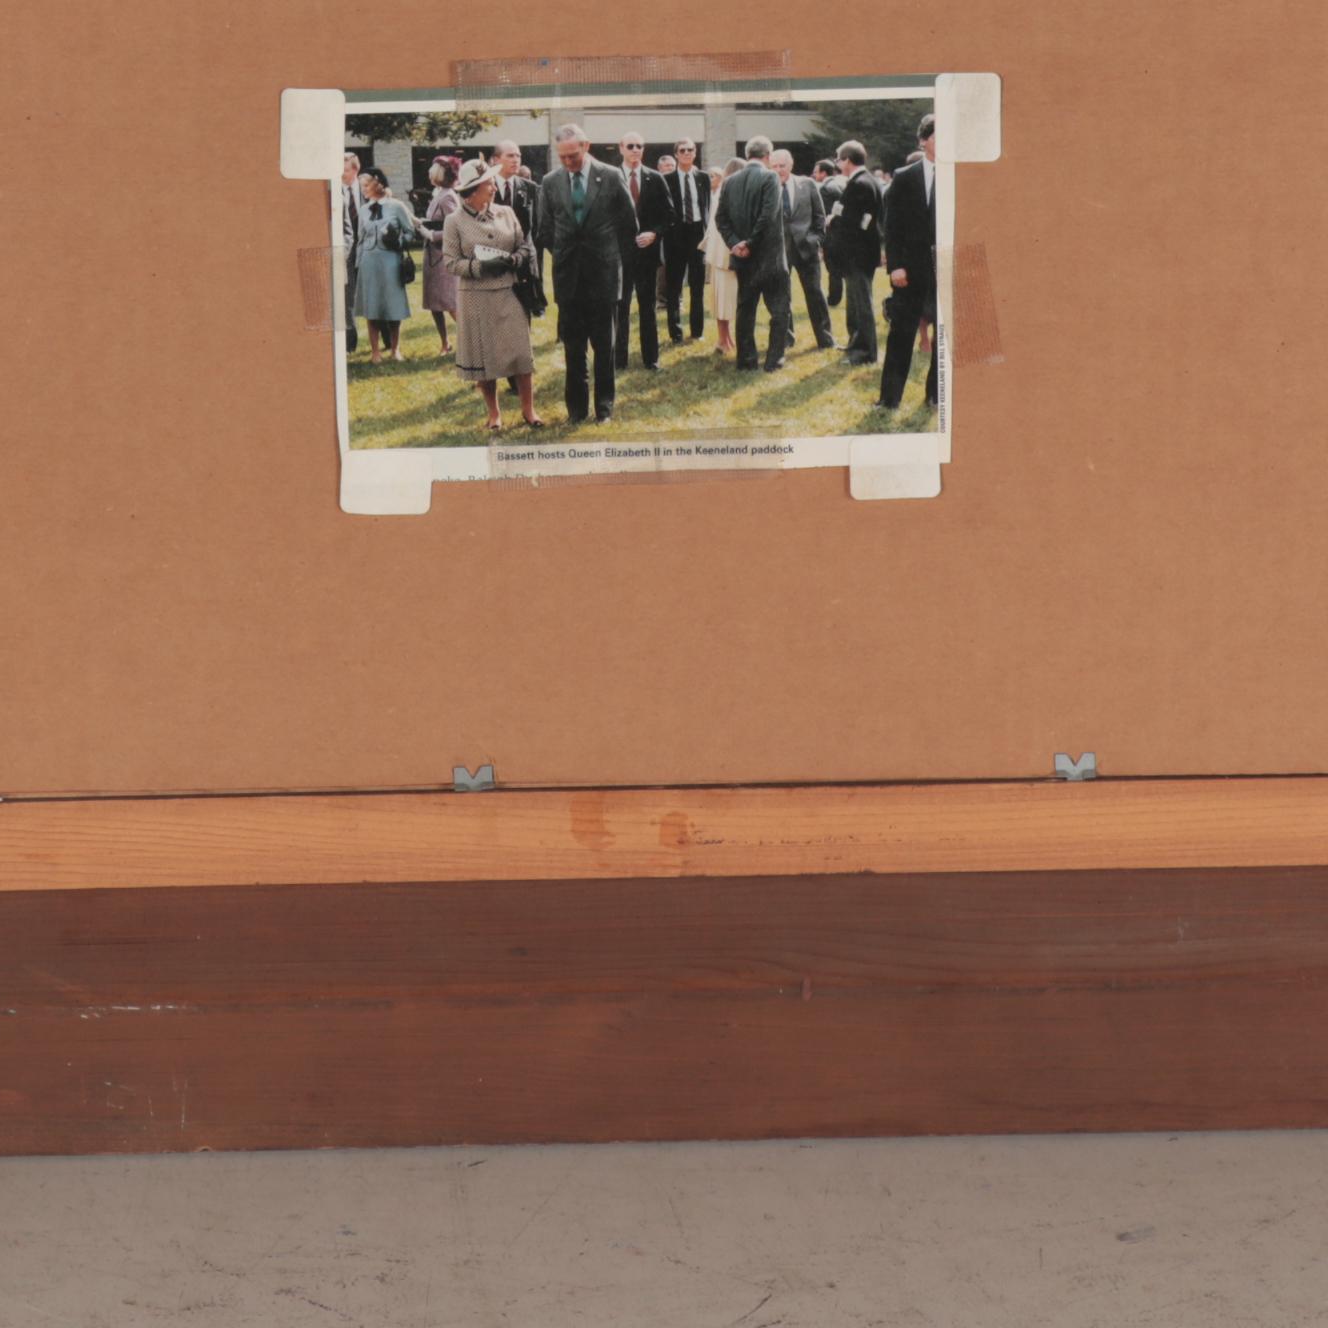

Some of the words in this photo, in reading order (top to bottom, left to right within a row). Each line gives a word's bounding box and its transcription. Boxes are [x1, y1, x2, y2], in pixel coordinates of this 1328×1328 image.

[496, 450, 536, 462] Bassett
[536, 449, 567, 461] hosts
[567, 448, 602, 459] Queen
[603, 447, 652, 458] Elizabeth
[652, 445, 662, 459] II
[662, 446, 673, 457] in
[674, 445, 693, 457] the
[694, 444, 749, 457] Keeneland
[750, 443, 795, 457] paddock
